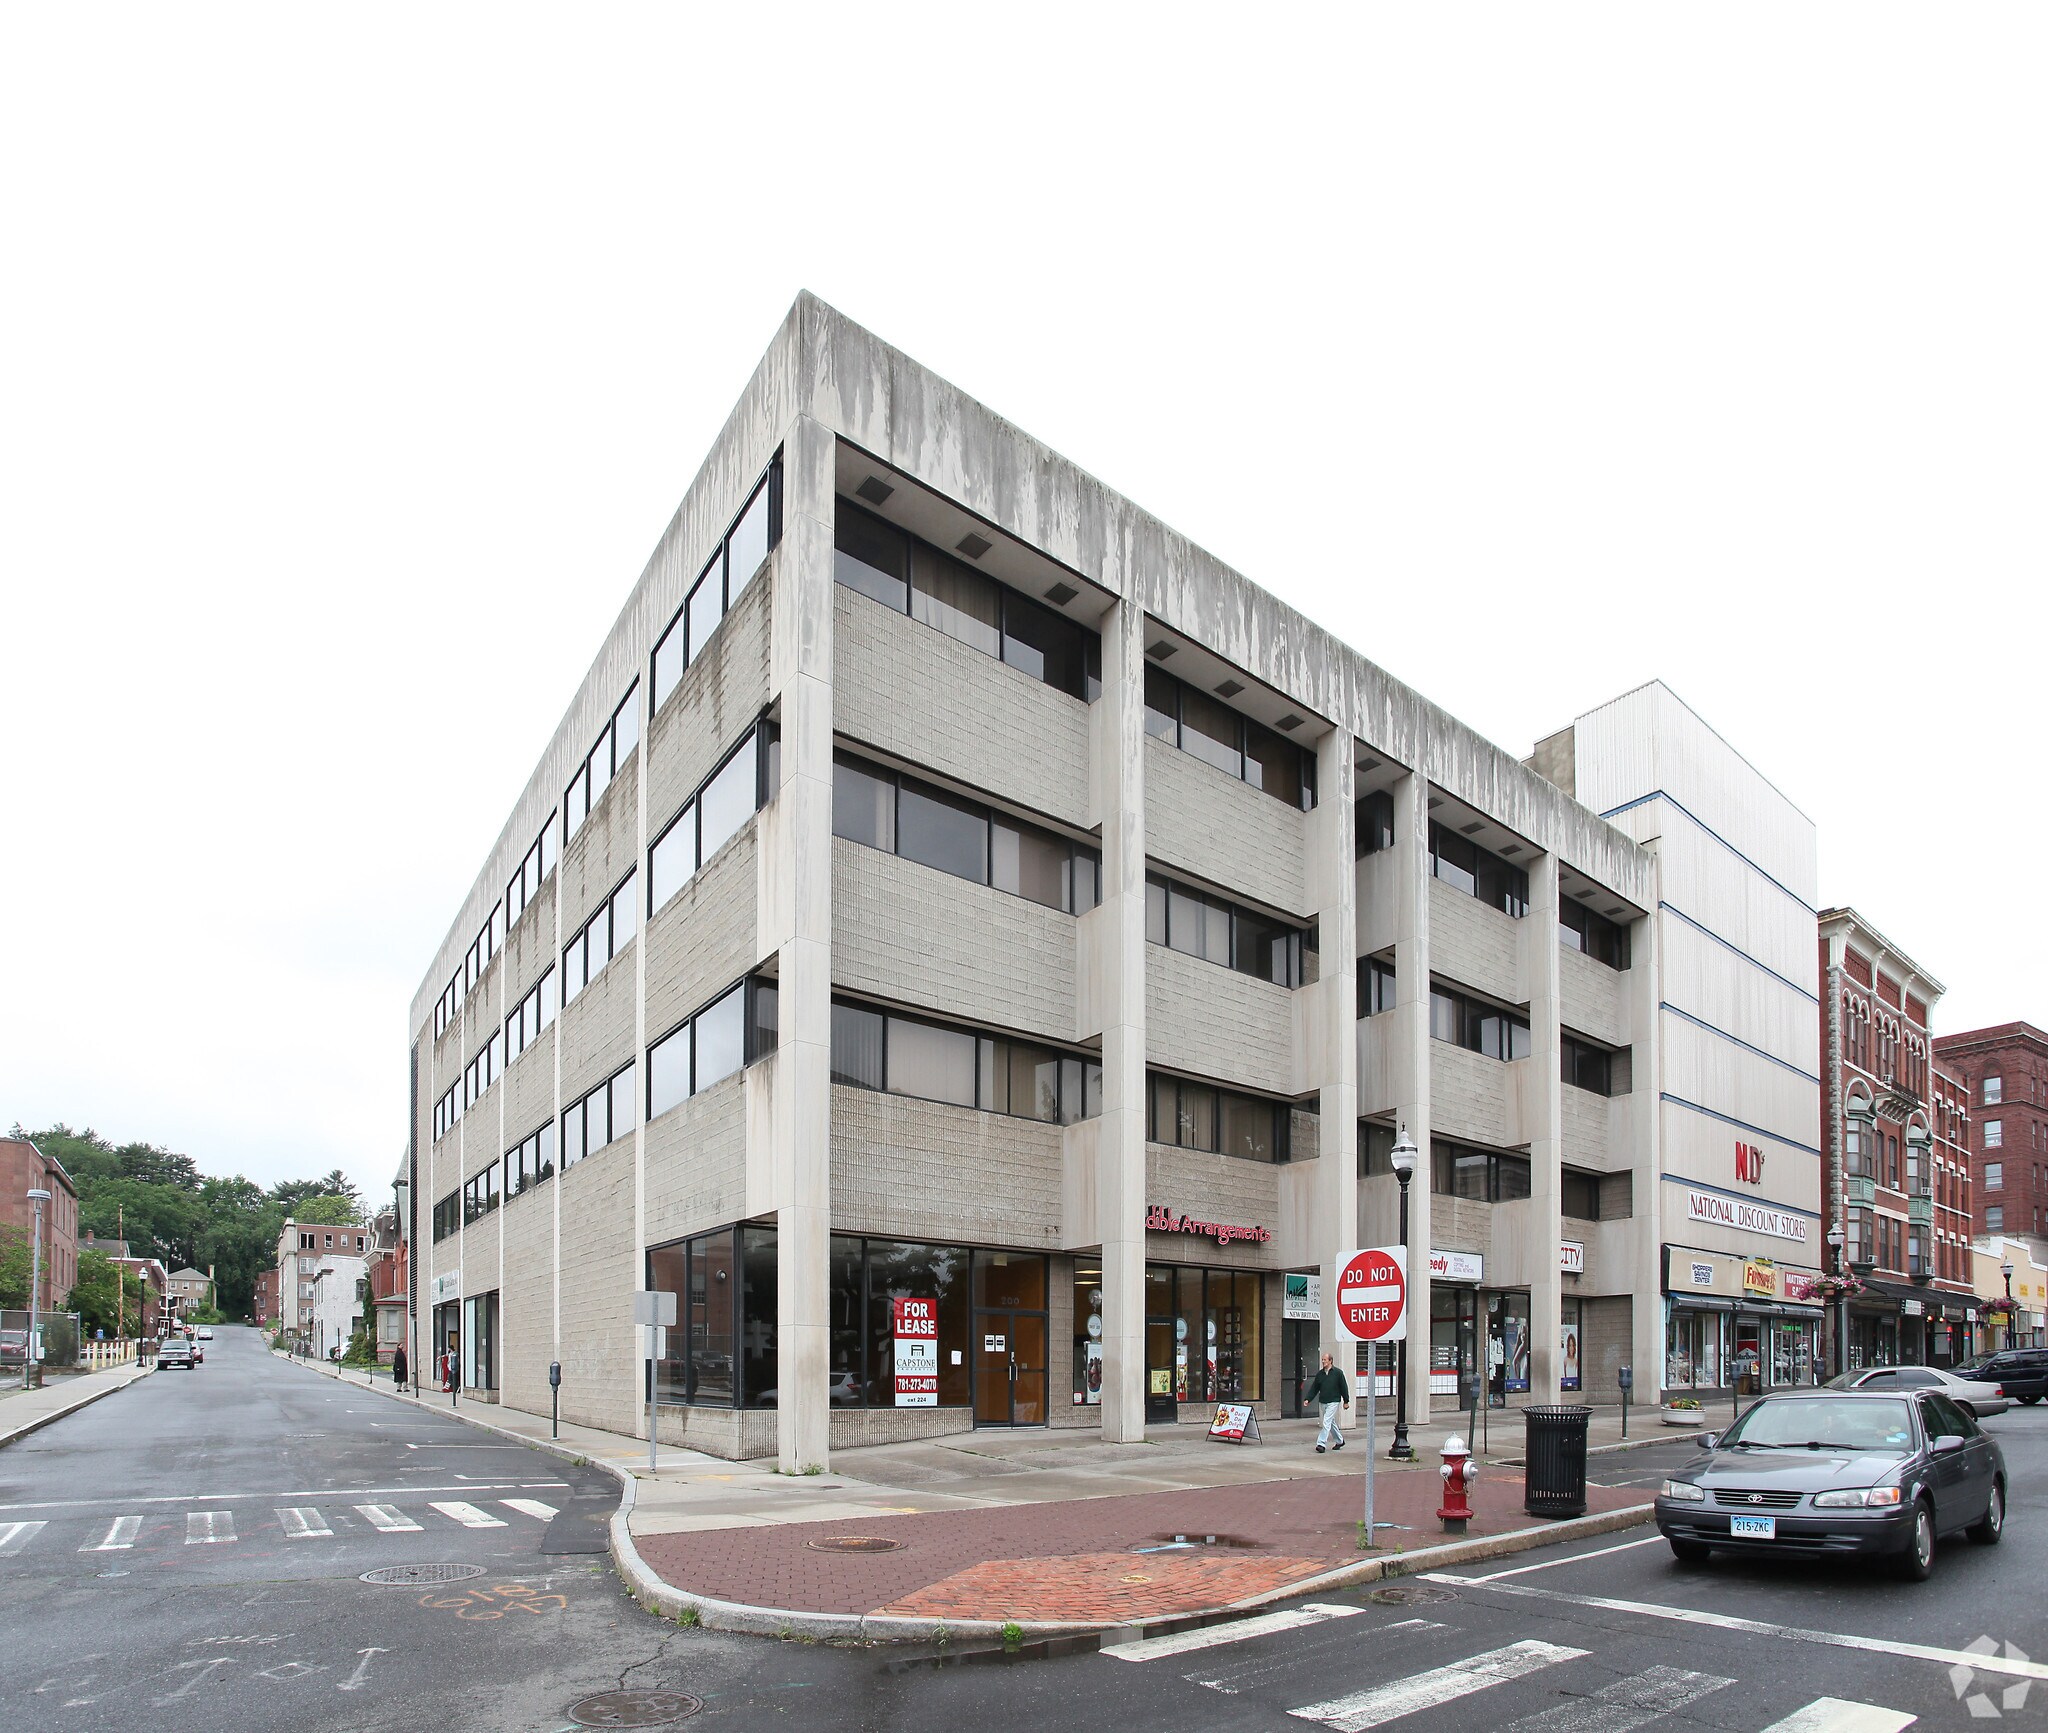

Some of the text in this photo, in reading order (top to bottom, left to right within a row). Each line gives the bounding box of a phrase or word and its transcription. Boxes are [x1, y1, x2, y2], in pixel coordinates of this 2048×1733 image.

[1690, 1194, 1806, 1239] NATIONAL DISCOUNT STORES
[1145, 1205, 1271, 1245] dible Arrangements
[1430, 1256, 1449, 1275] eedy
[1347, 1266, 1395, 1284] DO NOT
[1001, 1296, 1020, 1305] 200
[904, 1302, 928, 1317] FOR
[1351, 1307, 1389, 1322] ENTER
[896, 1319, 935, 1334] LEASE
[896, 1358, 936, 1368] CAPSTONE
[897, 1378, 937, 1391] 781-273-4070
